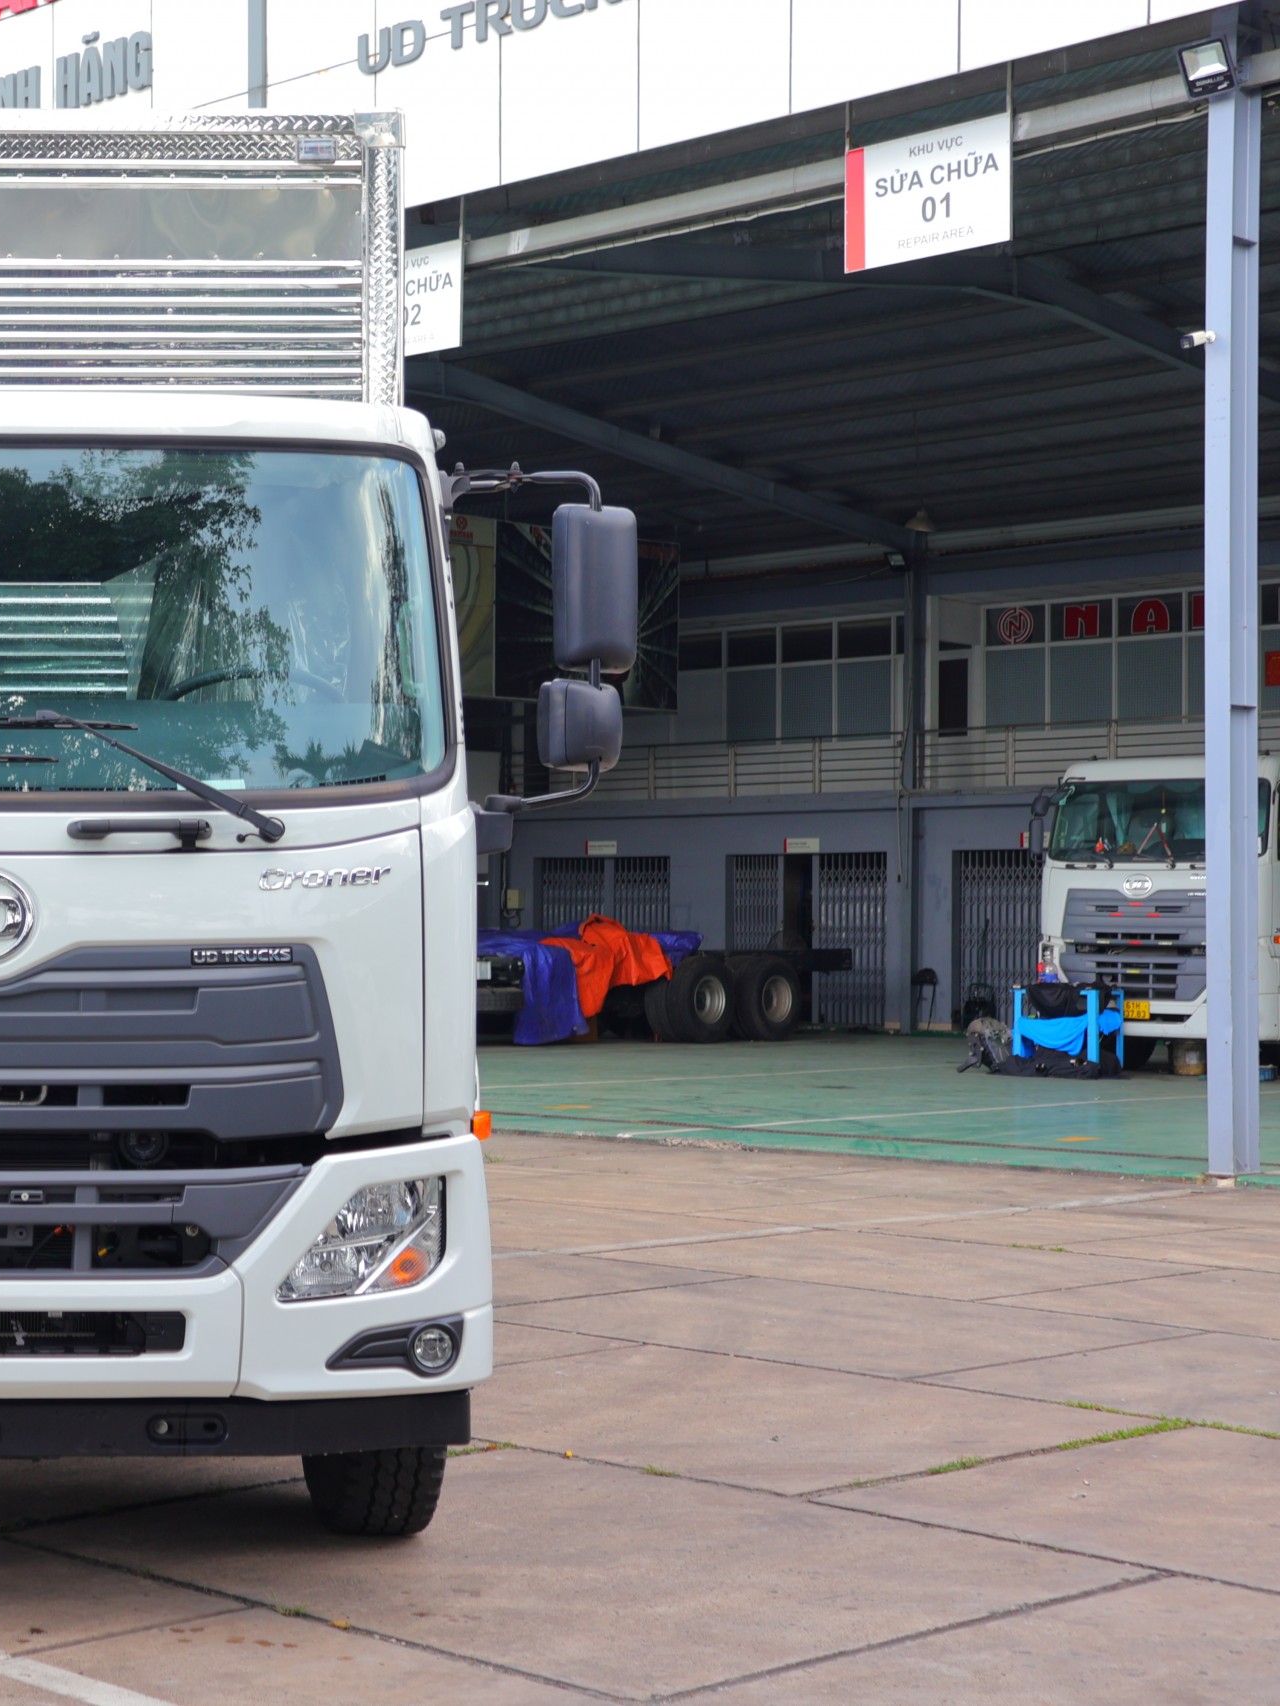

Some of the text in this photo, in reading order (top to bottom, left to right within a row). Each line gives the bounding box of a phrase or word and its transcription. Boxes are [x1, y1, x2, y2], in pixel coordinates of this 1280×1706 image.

[357, 20, 426, 75] UD
[56, 31, 153, 108] HÃNG
[908, 135, 963, 158] KHU VỰC
[875, 151, 999, 198] SỬA CHỮA
[921, 192, 951, 223] 01
[897, 225, 974, 250] REPAIR AREA
[405, 270, 453, 297] CHỮA
[258, 866, 391, 891] Croner
[193, 948, 292, 964] UD TRUCKS
